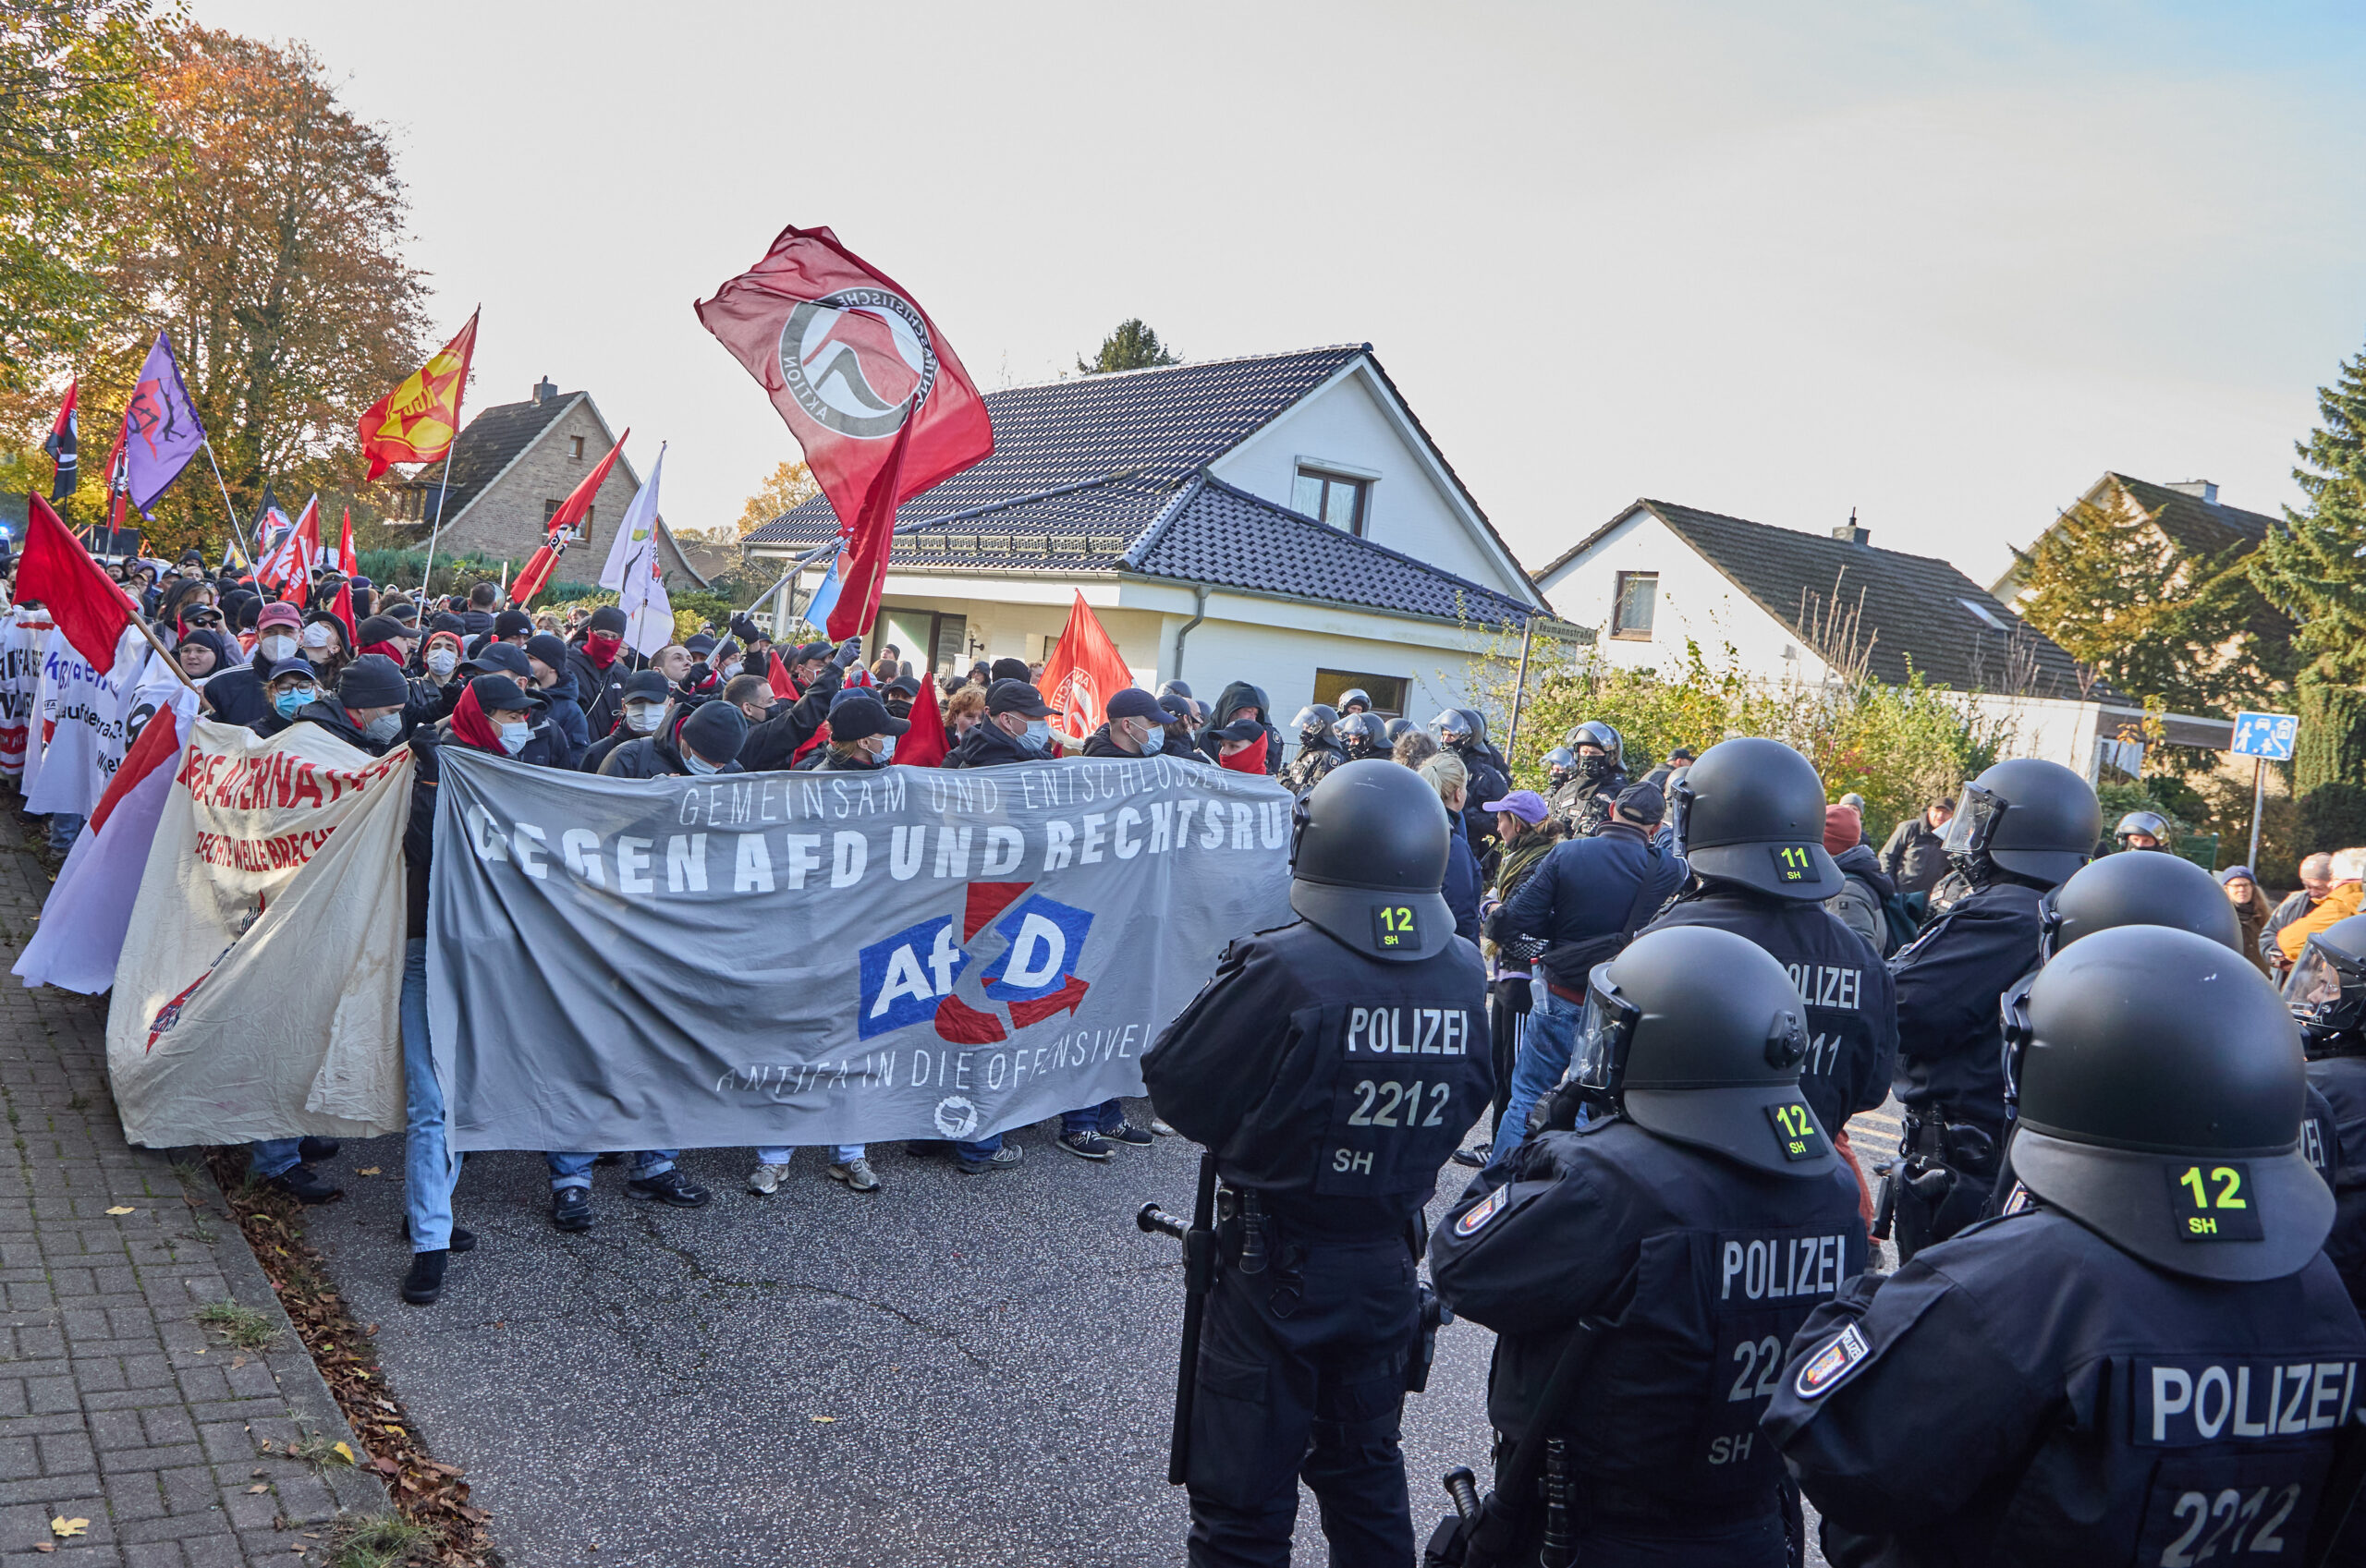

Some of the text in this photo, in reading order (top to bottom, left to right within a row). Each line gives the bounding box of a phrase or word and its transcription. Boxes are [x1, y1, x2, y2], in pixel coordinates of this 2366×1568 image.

[678, 756, 1229, 826] GEMEINSAM UND ENTSCHLOSSEN
[232, 837, 269, 872] WELLE
[467, 799, 1291, 894] GEGEN AFD UND RECHTSRU
[1781, 847, 1809, 869] 11
[1787, 870, 1801, 880] SH
[1380, 906, 1414, 932] 12
[1384, 935, 1399, 946] SH
[1787, 963, 1862, 1010] OLIZEI
[1348, 1007, 1468, 1055] POLIZEI
[716, 1024, 1152, 1094] ANTIFA IN DIE OFFENSIVE!
[1348, 1080, 1450, 1127] 2212
[1775, 1105, 1814, 1139] 12
[1333, 1149, 1374, 1175] SH
[1789, 1141, 1807, 1154] SH
[2179, 1166, 2248, 1209] 12
[2188, 1217, 2217, 1235] SH
[1722, 1234, 1847, 1301] POLIZEI
[2152, 1361, 2358, 1441] POLIZEI
[1708, 1432, 1753, 1465] SH
[2160, 1482, 2300, 1568] 2212
